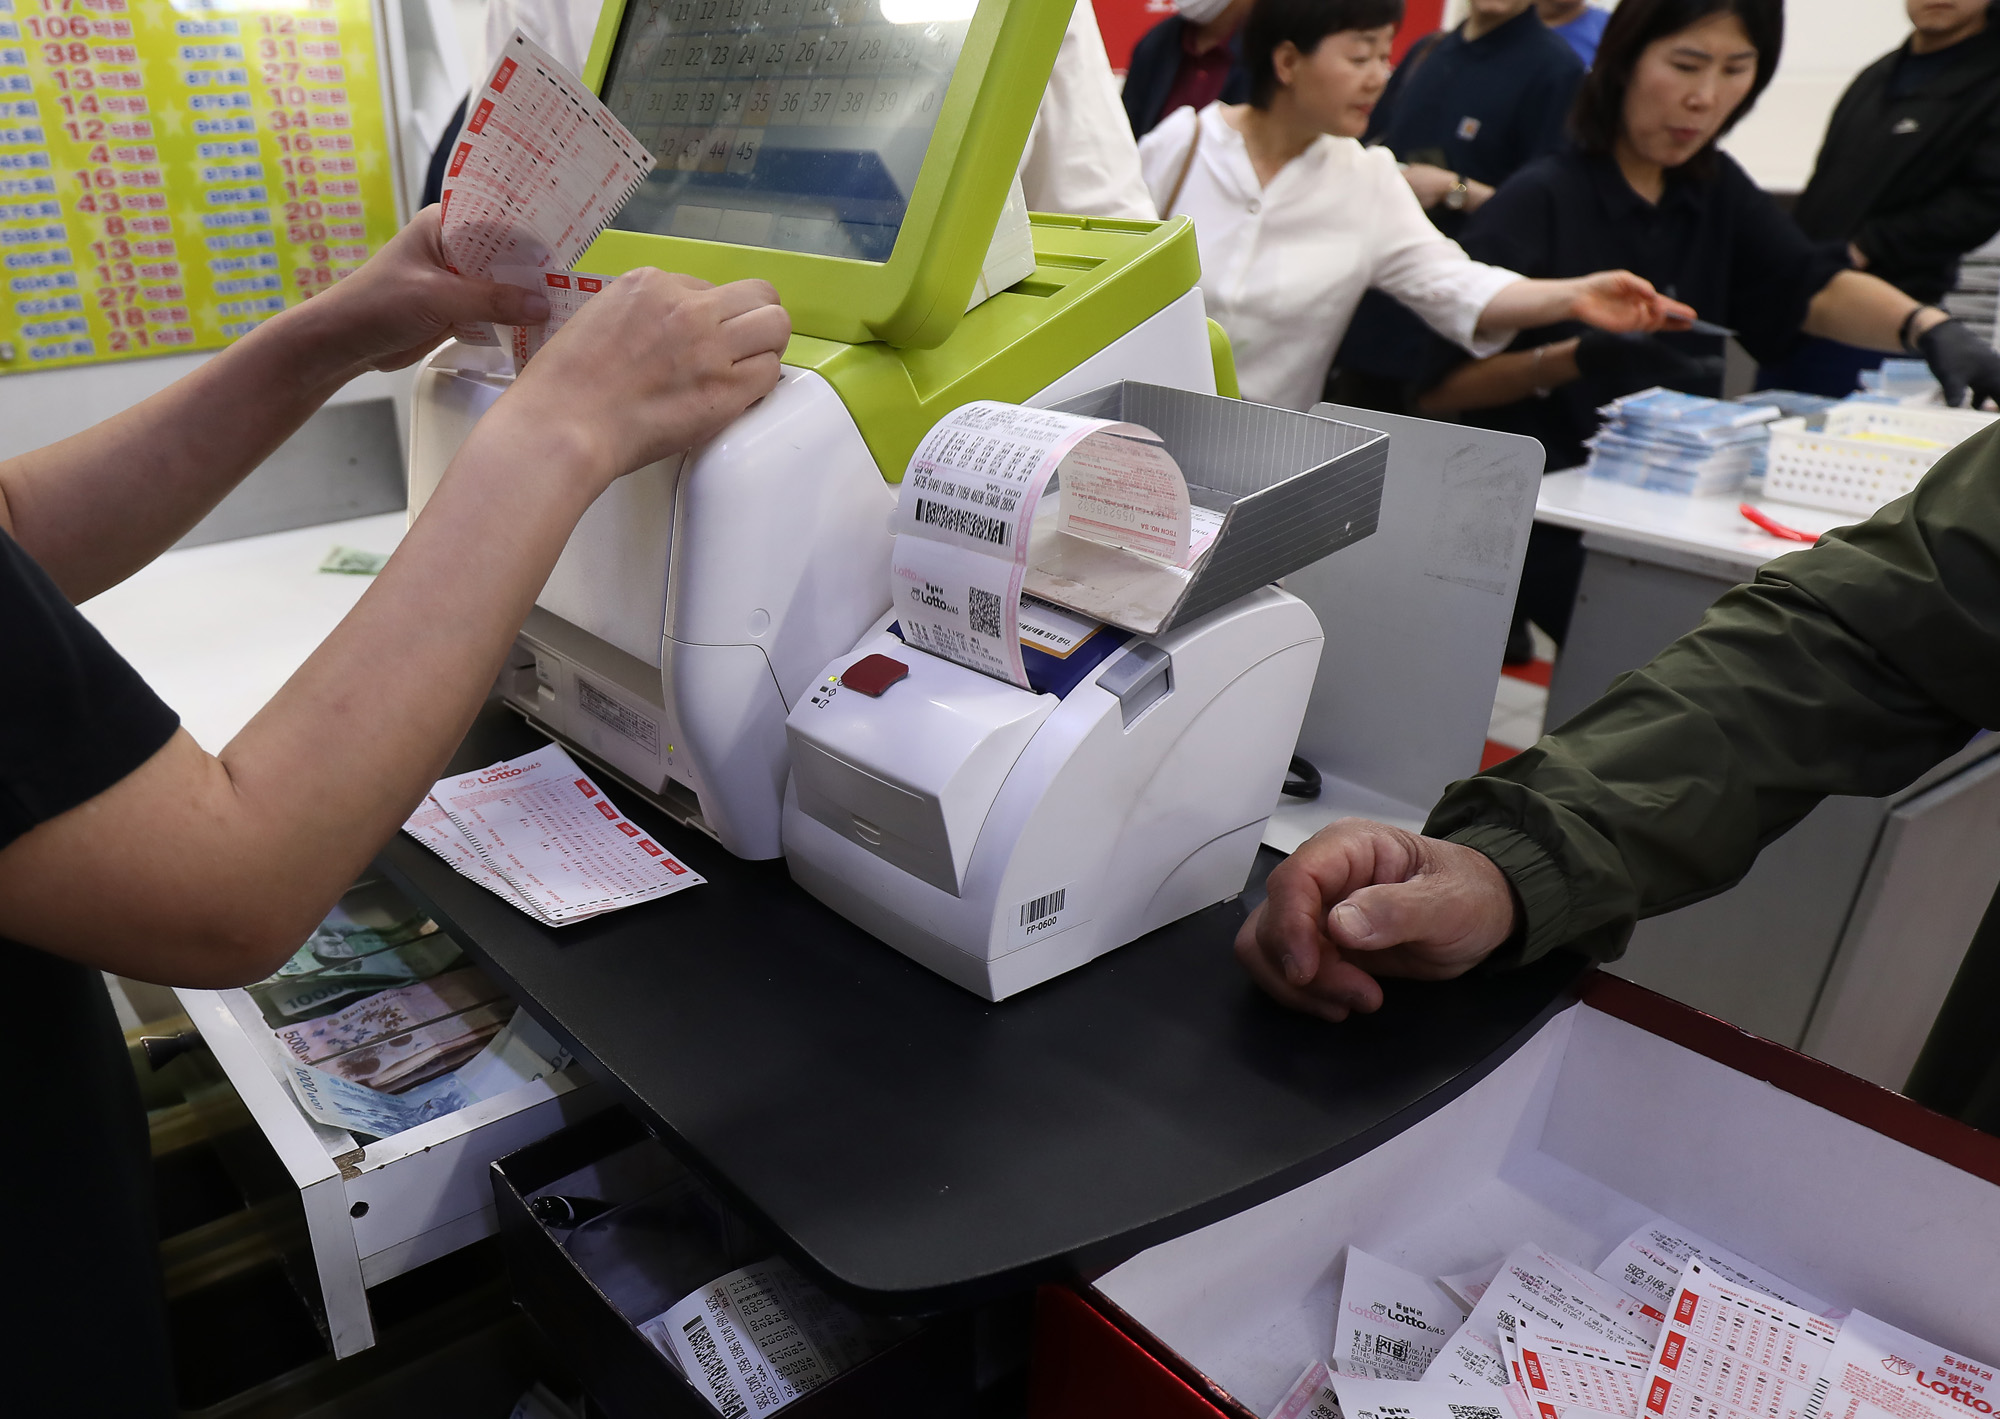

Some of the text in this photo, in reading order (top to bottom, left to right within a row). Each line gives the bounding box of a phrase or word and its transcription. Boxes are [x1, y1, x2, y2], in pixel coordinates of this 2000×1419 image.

[675, 4, 690, 21] 11
[700, 2, 717, 20] 12
[726, 0, 744, 18] 13
[26, 16, 89, 39] 106
[258, 14, 296, 35] 12
[43, 42, 89, 65] 38
[259, 38, 297, 60] 31
[661, 49, 676, 66] 21
[685, 48, 702, 65] 22
[711, 46, 729, 65] 23
[738, 45, 757, 64] 24
[765, 44, 785, 63] 25
[795, 42, 816, 62] 26
[826, 41, 848, 61] 27
[858, 39, 881, 60] 28
[52, 68, 94, 91] 13
[261, 62, 301, 85] 27
[58, 94, 99, 115] 14
[267, 85, 307, 106] 10
[648, 94, 663, 111] 31
[672, 94, 688, 111] 32
[699, 93, 715, 111] 33
[723, 93, 741, 111] 34
[751, 93, 770, 111] 35
[779, 93, 800, 112] 36
[810, 93, 831, 112] 37
[841, 92, 864, 112] 38
[875, 92, 898, 112] 39
[64, 119, 105, 142] 12
[270, 110, 308, 130] 34
[89, 144, 110, 163] 4
[276, 132, 313, 153] 16
[709, 141, 727, 158] 44
[737, 142, 754, 160] 45
[279, 156, 316, 176] 16
[75, 168, 116, 189] 16
[284, 179, 318, 199] 14
[76, 192, 121, 213] 43
[284, 200, 323, 221] 20
[105, 215, 126, 237] 8
[90, 238, 131, 260] 13
[310, 244, 329, 263] 9
[97, 262, 136, 283] 13
[97, 285, 138, 308] 27
[107, 329, 149, 351] 21
[921, 590, 948, 611] Lotto
[478, 769, 522, 783] Lotto
[1026, 916, 1057, 935] FP-0600
[342, 1005, 365, 1020] Bank
[284, 1030, 310, 1054] 5000
[295, 1067, 323, 1110] 1000 won
[1625, 1263, 1665, 1291] 59025 91496
[771, 1294, 816, 1369] 06 09 22 41 42
[1388, 1309, 1446, 1336] Lotto 6/45
[742, 1305, 794, 1397] 02 08 14 19 25 26
[749, 1302, 803, 1393] 09 12 13 17 21 34
[756, 1299, 810, 1391] 01 04 10 12 23 42
[764, 1297, 818, 1388] 11 14 15 18 28 38
[1464, 1362, 1483, 1377] 53195
[1943, 1355, 1993, 1381] 동행복권
[1936, 1367, 1985, 1393] 동행복권
[1916, 1370, 1993, 1413] Lotto
